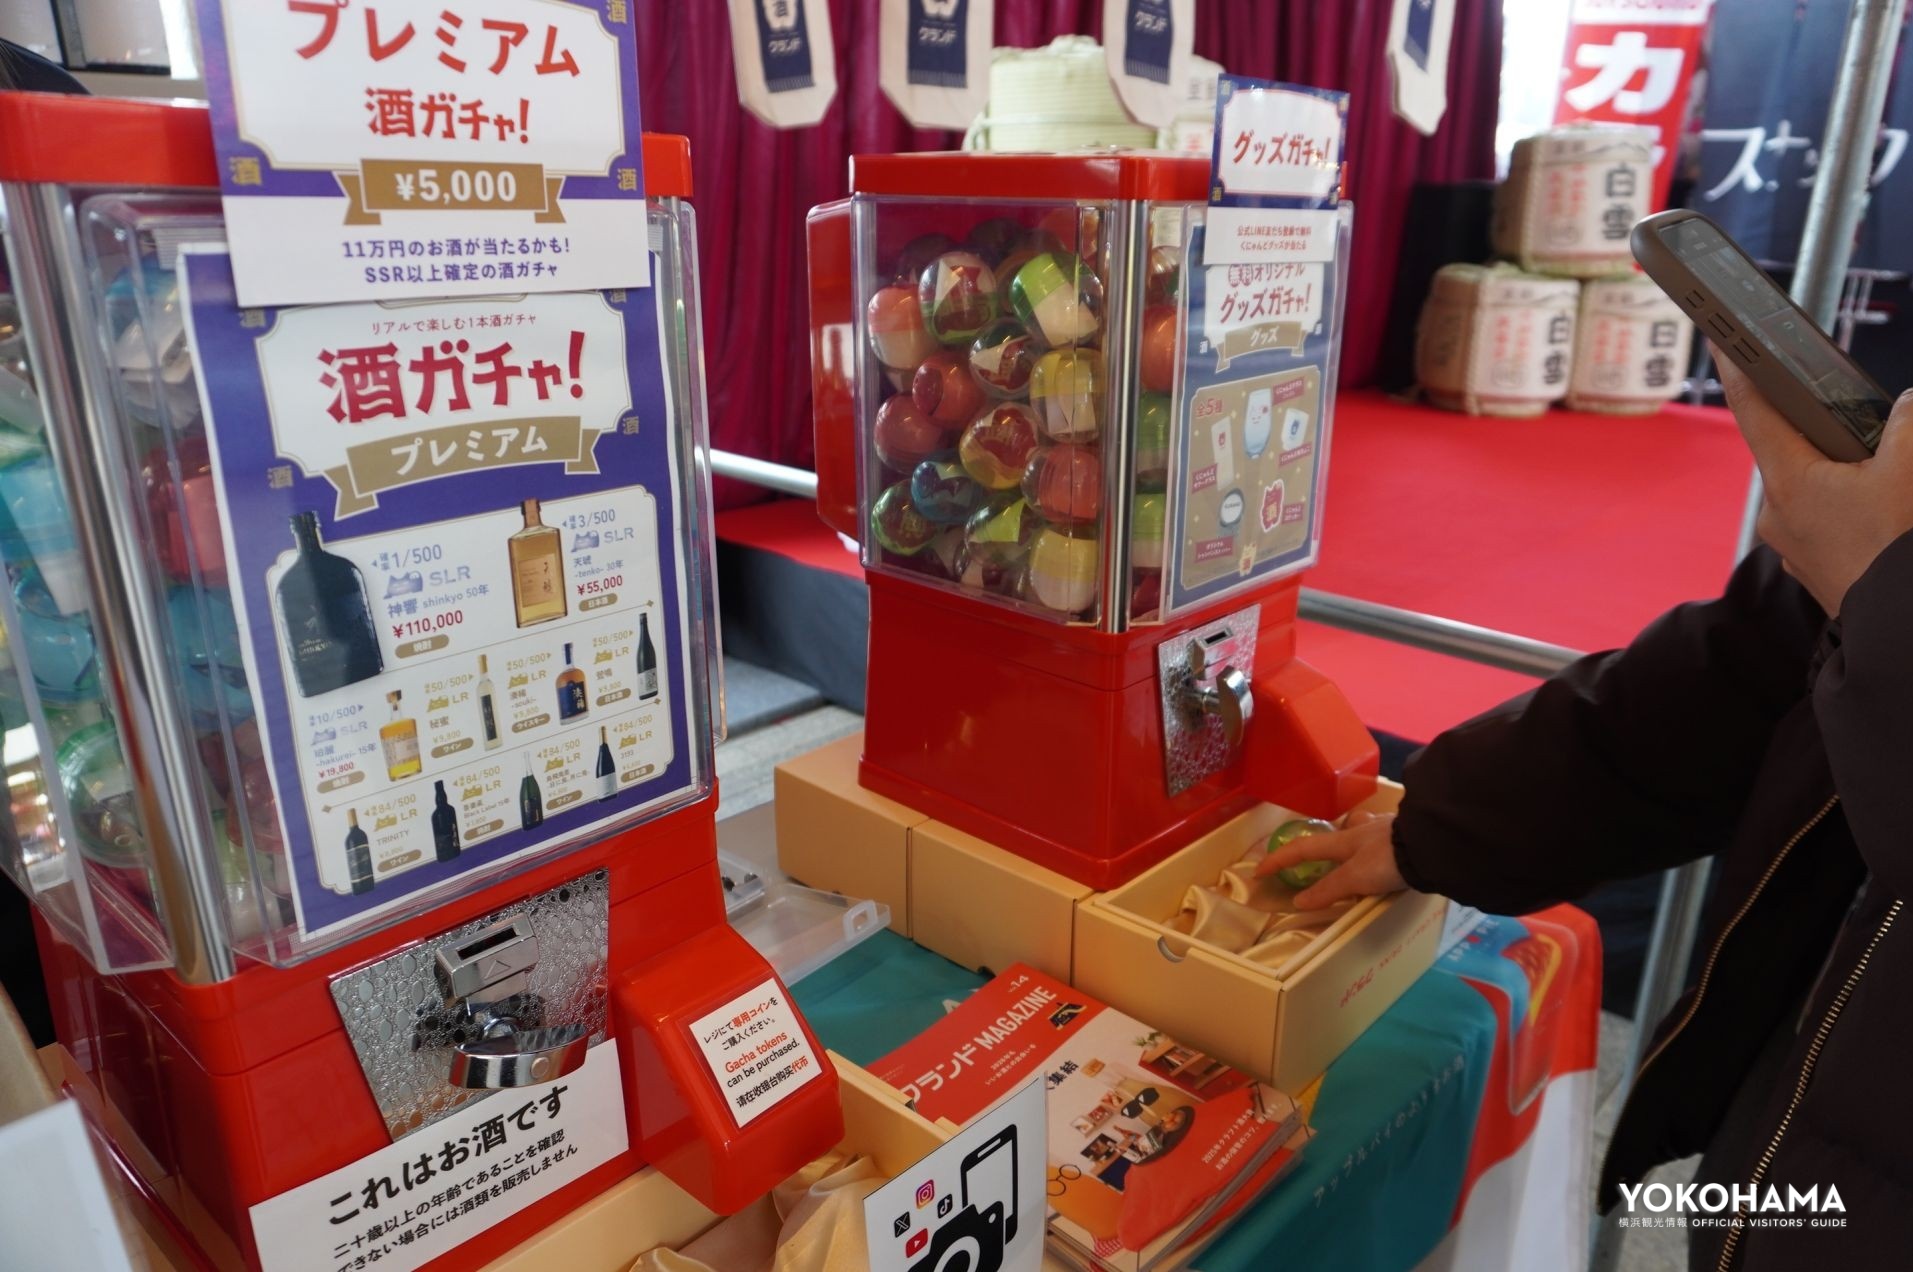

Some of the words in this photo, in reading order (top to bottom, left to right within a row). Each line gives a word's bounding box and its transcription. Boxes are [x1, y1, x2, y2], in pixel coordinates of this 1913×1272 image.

[287, 0, 580, 78] プレミアム
[365, 87, 530, 144] 酒ガチャ!
[1233, 129, 1331, 166] グッズガチャ!
[229, 156, 262, 186] 酒
[617, 168, 637, 192] 酒
[396, 169, 517, 205] ¥5,000
[342, 237, 571, 259] 11万円のお酒が当たるかも!
[364, 262, 558, 284] SSR以上確定の酒ガチャ
[1220, 283, 1311, 323] グッズガチャ!
[371, 314, 537, 335] リアルで楽しむ1本酒ガチャ
[317, 330, 585, 424] 酒ガチャ!
[622, 416, 640, 435] 酒
[391, 425, 548, 476] プレミアム
[268, 465, 294, 489] 酒
[578, 508, 616, 528] 3/500
[604, 527, 634, 544] SLR
[392, 544, 442, 568] 1/500
[429, 565, 471, 586] SLR
[577, 575, 622, 595] ¥55,000
[423, 593, 463, 609] shinkyo
[466, 584, 489, 598] 50年
[392, 609, 463, 638] ¥110,000
[615, 646, 629, 657] LR
[531, 669, 546, 680] LR
[453, 692, 469, 704] LR
[340, 721, 367, 735] SLR
[401, 809, 418, 820] LR
[704, 997, 778, 1043] レジにて専用コインを
[974, 986, 1057, 1050] MAGAZINE
[722, 1016, 776, 1050] ご購入ください。
[725, 1051, 757, 1073] Gacha
[756, 1032, 788, 1055] tokens
[727, 1073, 744, 1088] can
[744, 1065, 756, 1079] be
[756, 1038, 800, 1072] purchased.
[736, 1056, 809, 1107] 请在收银台购买代币
[329, 1084, 568, 1226] これはお酒です
[334, 1128, 566, 1259] 二十歳以上の年齢であることを確認
[336, 1144, 578, 1272] できない場合には酒類を販売しません
